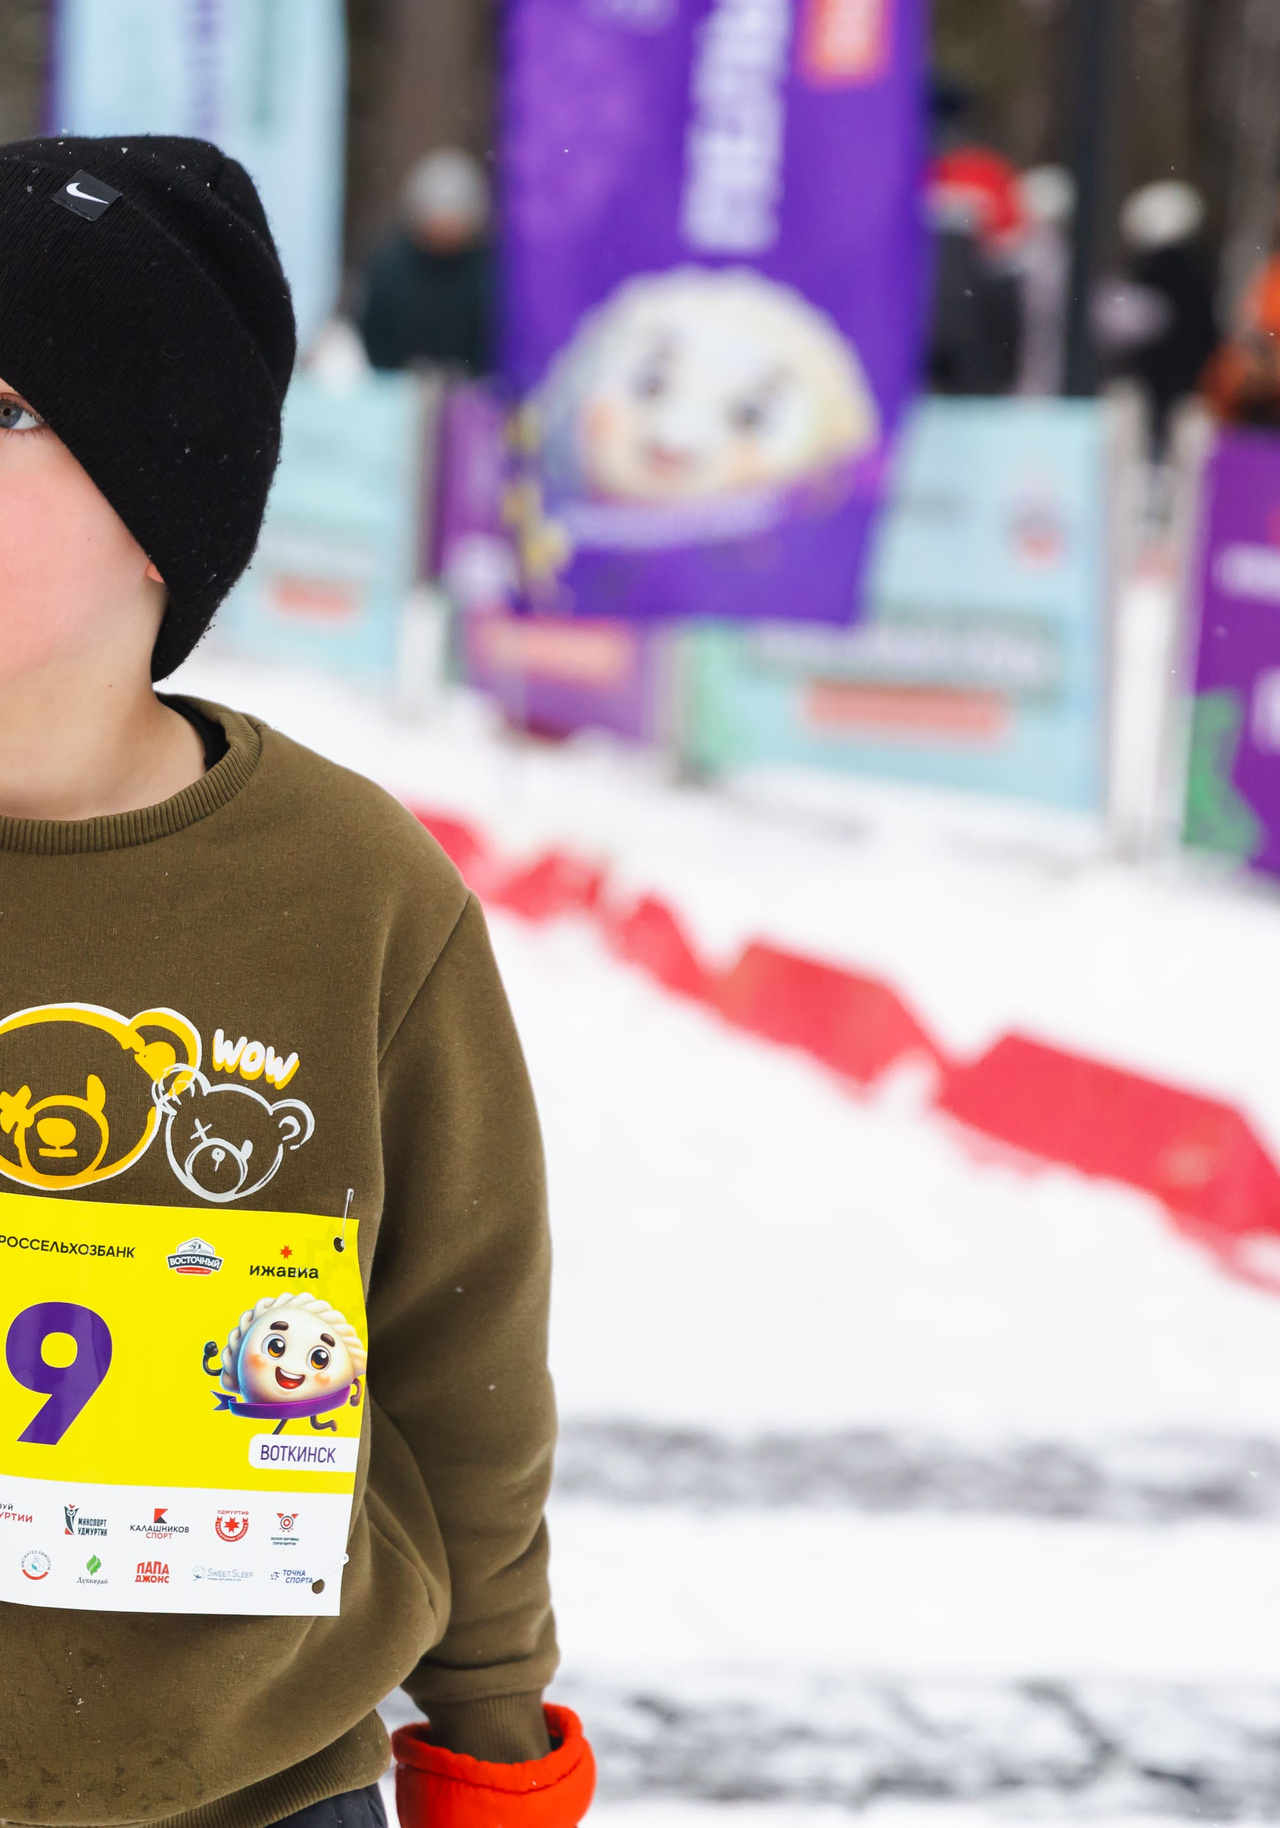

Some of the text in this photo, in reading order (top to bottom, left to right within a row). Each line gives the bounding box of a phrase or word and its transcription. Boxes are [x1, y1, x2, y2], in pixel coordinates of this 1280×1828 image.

[169, 1255, 221, 1269] ВОСТОЧНЫЙ
[260, 1444, 337, 1464] ВОТКИНСК
[77, 1517, 108, 1527] МИНСПОРТ
[77, 1527, 108, 1537] УДМУРТИИ
[130, 1524, 190, 1534] КАЛАШНИКОВ
[145, 1532, 173, 1540] СПОРТ
[136, 1560, 170, 1575] ПАПА
[283, 1569, 307, 1577] ТОЧКА
[135, 1574, 170, 1584] ДЖОНС
[285, 1576, 314, 1584] СПОРТА
